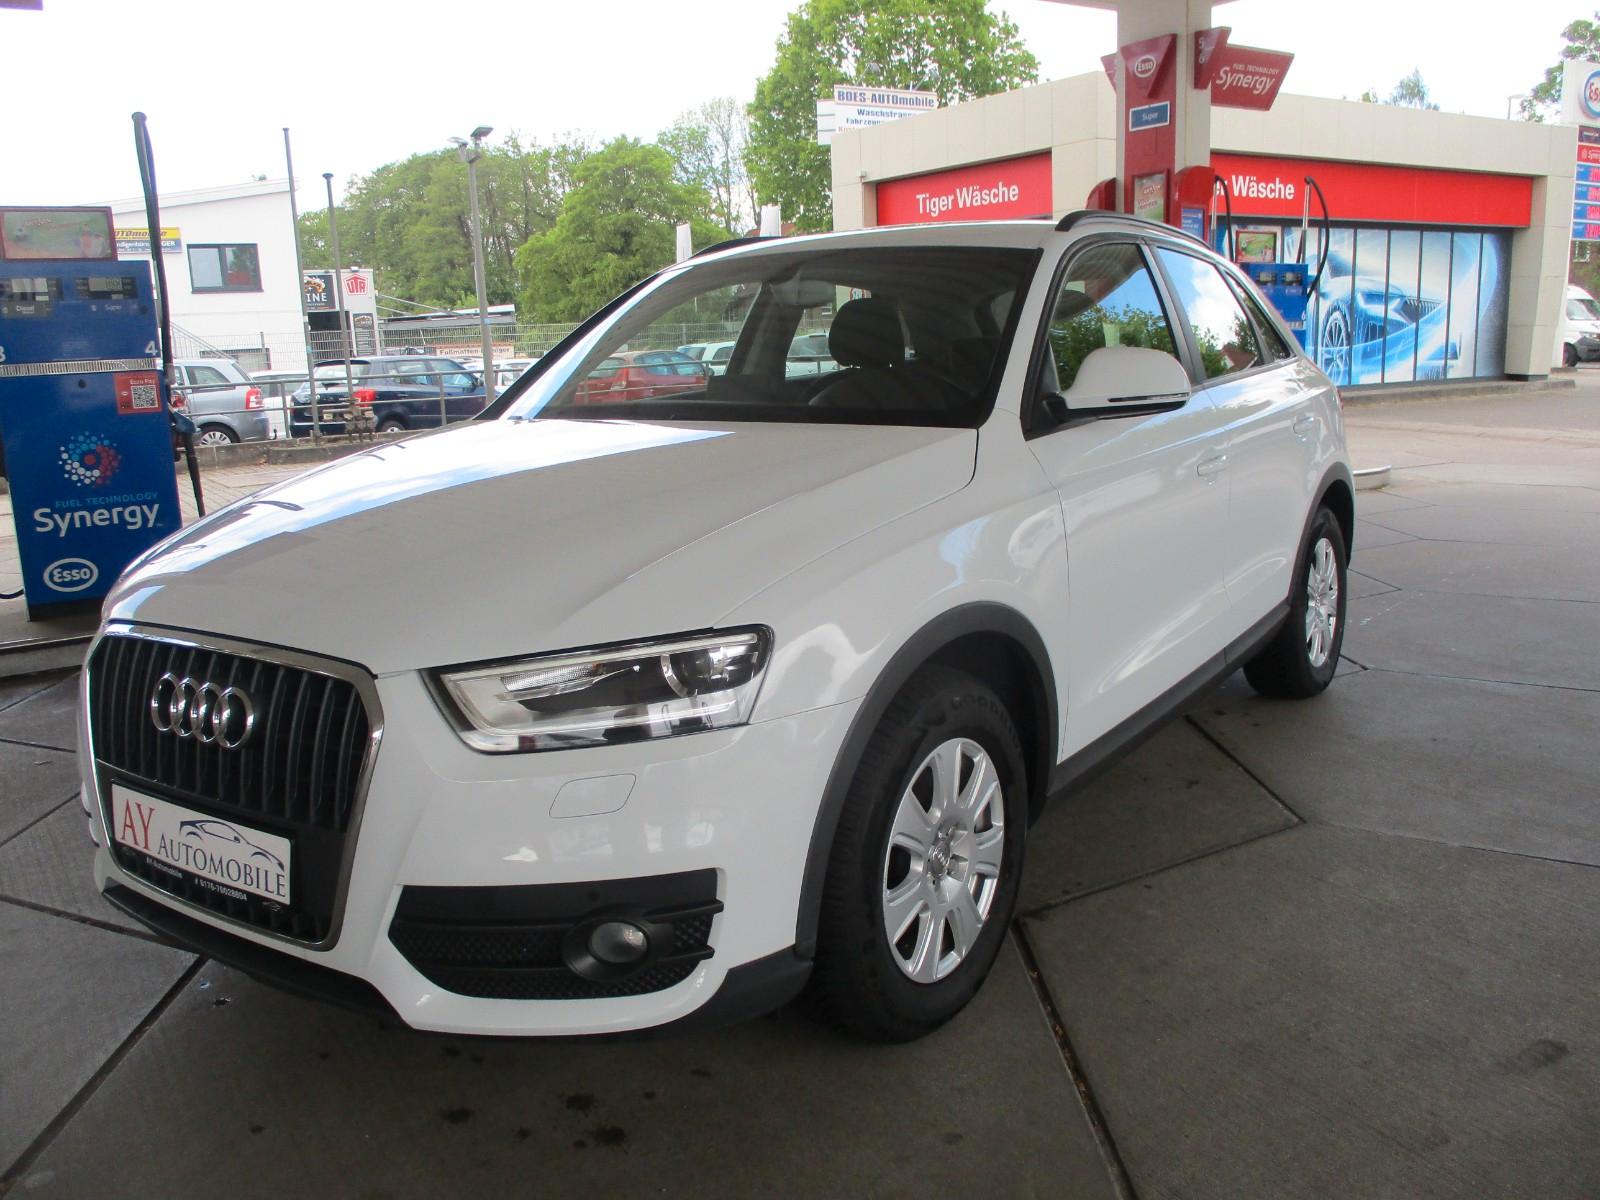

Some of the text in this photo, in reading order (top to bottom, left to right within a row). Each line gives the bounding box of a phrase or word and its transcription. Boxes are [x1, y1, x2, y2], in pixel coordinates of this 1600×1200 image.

[1232, 63, 1280, 75] FUEL TECHNOLOGY
[1216, 66, 1276, 95] Synergy
[1588, 81, 1600, 102] Es
[1142, 112, 1159, 122] Super
[1232, 175, 1295, 200] Wäsche
[916, 181, 1019, 217] Tiger Wäsche
[305, 292, 327, 302] INE
[347, 280, 366, 293] UTA
[145, 340, 158, 356] 4
[55, 491, 159, 509] FUEL TECHNOLOGY
[33, 503, 160, 537] Synergy
[120, 798, 155, 851] AY
[157, 833, 287, 898] AUTOMOBILE
